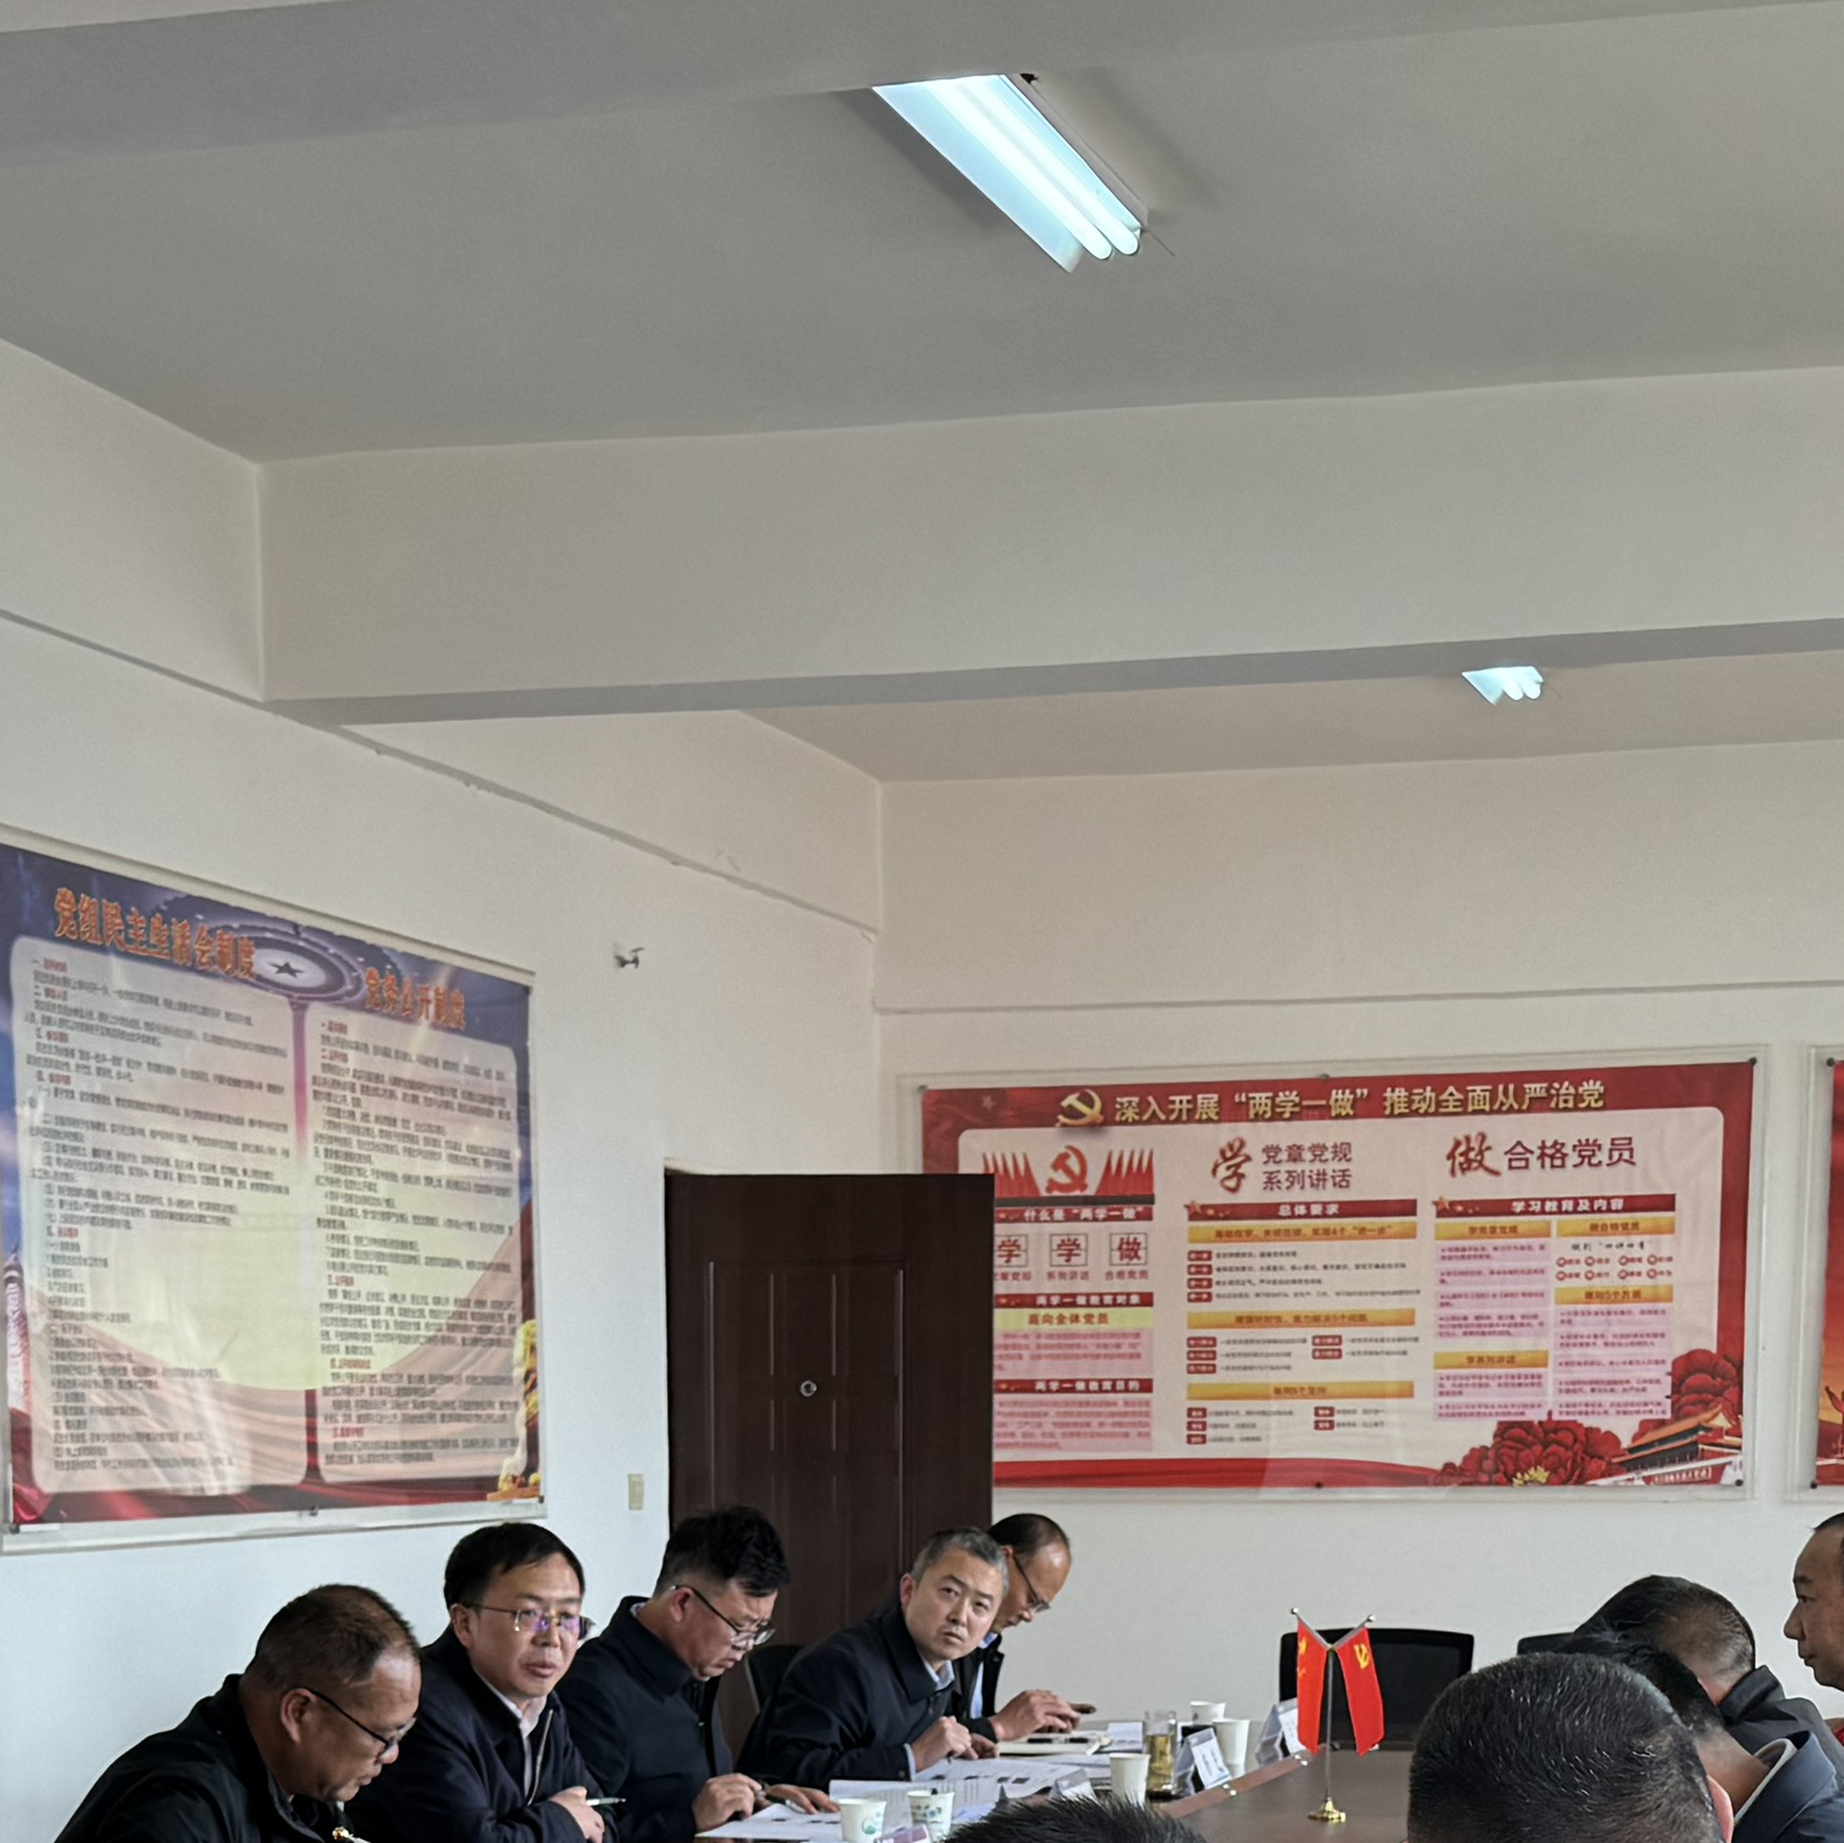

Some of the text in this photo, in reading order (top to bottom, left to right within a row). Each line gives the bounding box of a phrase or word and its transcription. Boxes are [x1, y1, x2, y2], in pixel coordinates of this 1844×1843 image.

[54, 886, 256, 979] 党组民主生活会制度
[1211, 1136, 1253, 1193] 学
[1262, 1142, 1353, 1166] 党章党规
[1446, 1132, 1637, 1177] 做 合格党员
[1262, 1167, 1353, 1190] 系列讲话
[1511, 1198, 1625, 1213] 学习教育及内容
[997, 1236, 1142, 1264] 学 学 做
